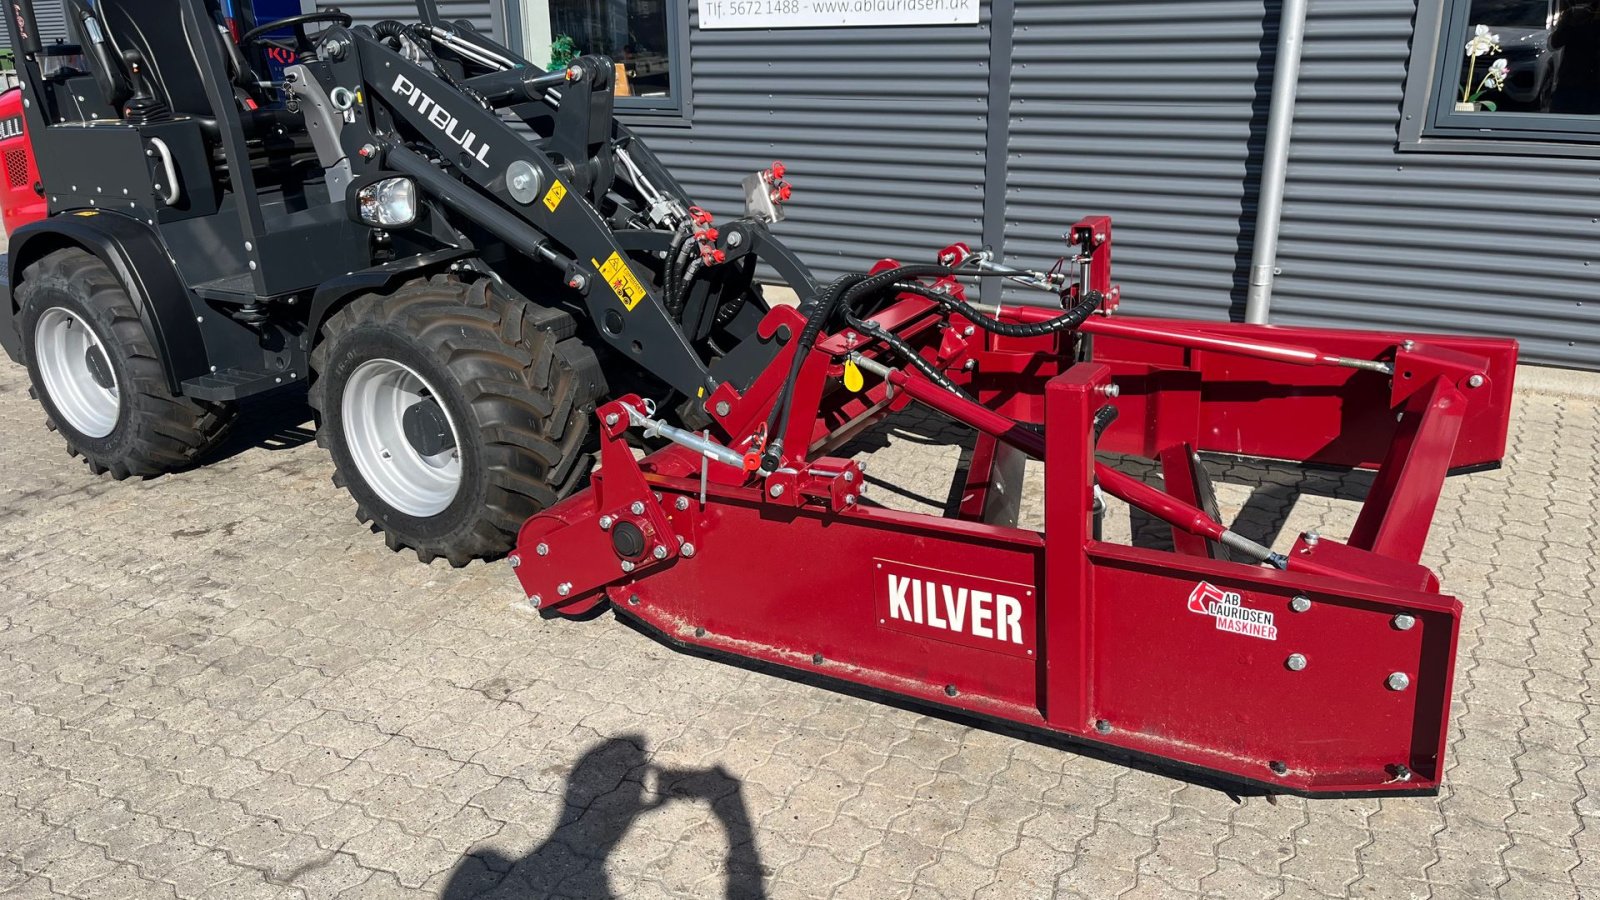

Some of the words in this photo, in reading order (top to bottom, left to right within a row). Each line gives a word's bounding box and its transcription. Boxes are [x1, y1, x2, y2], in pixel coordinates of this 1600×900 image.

[706, 2, 726, 19] Tlf.
[730, 1, 762, 15] 5672
[766, 0, 799, 14] 1488
[391, 73, 490, 168] PITBULL
[887, 573, 1024, 645] KILVER
[1224, 593, 1239, 606] AB
[1210, 602, 1272, 625] LAURIDSEN
[1217, 616, 1276, 638] MASKINER
